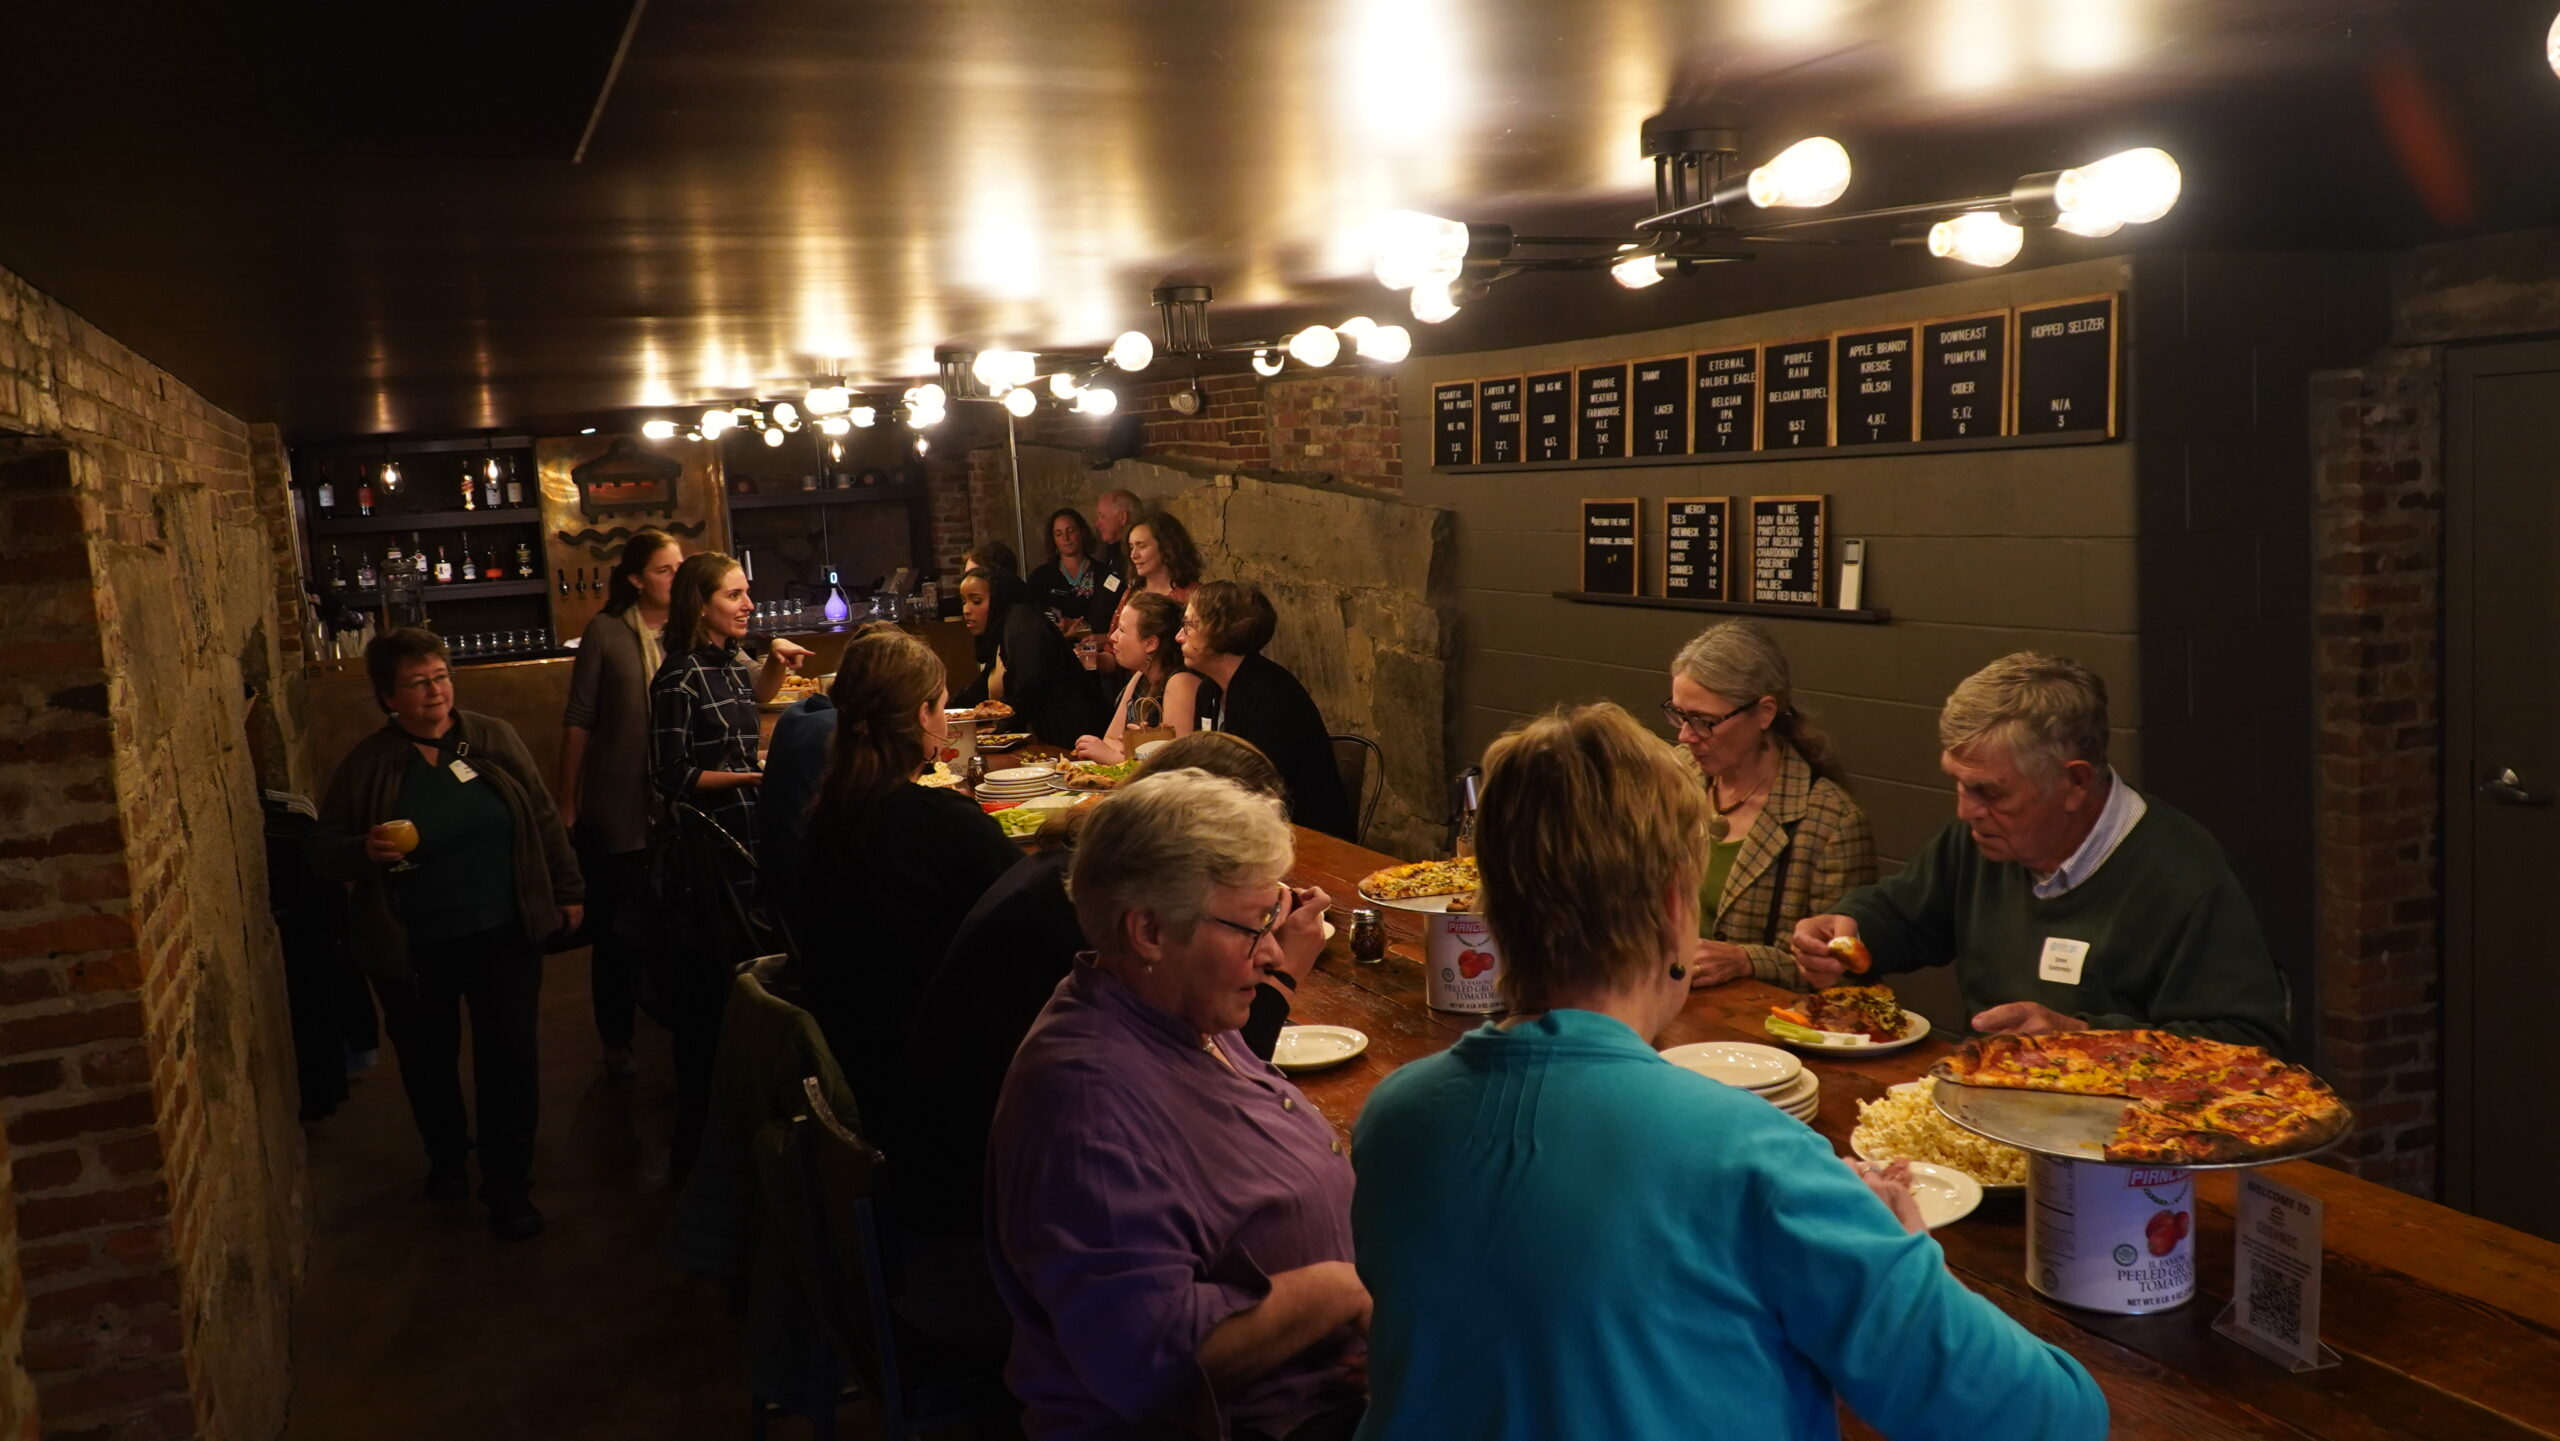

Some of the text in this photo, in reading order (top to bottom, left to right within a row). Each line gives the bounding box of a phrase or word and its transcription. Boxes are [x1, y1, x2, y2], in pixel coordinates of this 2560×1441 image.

[2031, 317, 2105, 338] HOPPED SELTZER
[1940, 326, 1988, 344] DOWNEAST
[1849, 340, 1908, 358] APPLE BRANDY
[1784, 352, 1814, 365] PURPLE
[1944, 349, 1987, 365] PUMPKIN
[1708, 358, 1746, 371] ETERNAL
[1788, 366, 1810, 378] RAIN
[1700, 372, 1756, 388] GOLDEN EAGLE
[1484, 385, 1506, 396] LAWYER
[1951, 381, 1976, 394] CIDER
[1590, 392, 1618, 404] WEATHER
[1768, 386, 1828, 403] BELGIAN TRIPEL
[1491, 400, 1512, 410] COFFEE
[1711, 395, 1742, 408] BELGIAN
[2051, 398, 2071, 411] N/A
[1586, 407, 1621, 418] FARMHOUSE
[1654, 404, 1674, 415] LAGER
[1720, 410, 1734, 420] IPA
[1498, 414, 1520, 423] PORTER
[1595, 419, 1608, 429] ALE
[2058, 415, 2064, 428] 3
[1958, 422, 1966, 434] 6
[1872, 428, 1878, 440] 7
[1721, 436, 1726, 446] 7
[1778, 504, 1798, 514] WINE
[1671, 514, 1686, 524] TEES
[1776, 515, 1800, 525] BLANC
[1757, 526, 1776, 536] PINOT
[1776, 526, 1800, 536] GRIGIO
[1757, 537, 1770, 546] DRY
[1772, 536, 1804, 548] RIESLING
[1711, 553, 1717, 563] 4
[1756, 548, 1799, 558] CHARDONNAY
[1756, 558, 1790, 568] CABERNET
[1756, 568, 1776, 579] PINOT
[1669, 578, 1688, 587] SOCKS
[1756, 580, 1782, 590] MALBEC
[1777, 592, 1790, 601] RED
[1790, 592, 1812, 602] BLEND
[2248, 1180, 2311, 1216] WELCOME TO
[2117, 1268, 2167, 1282] PEELED
[2127, 1298, 2140, 1306] NET
